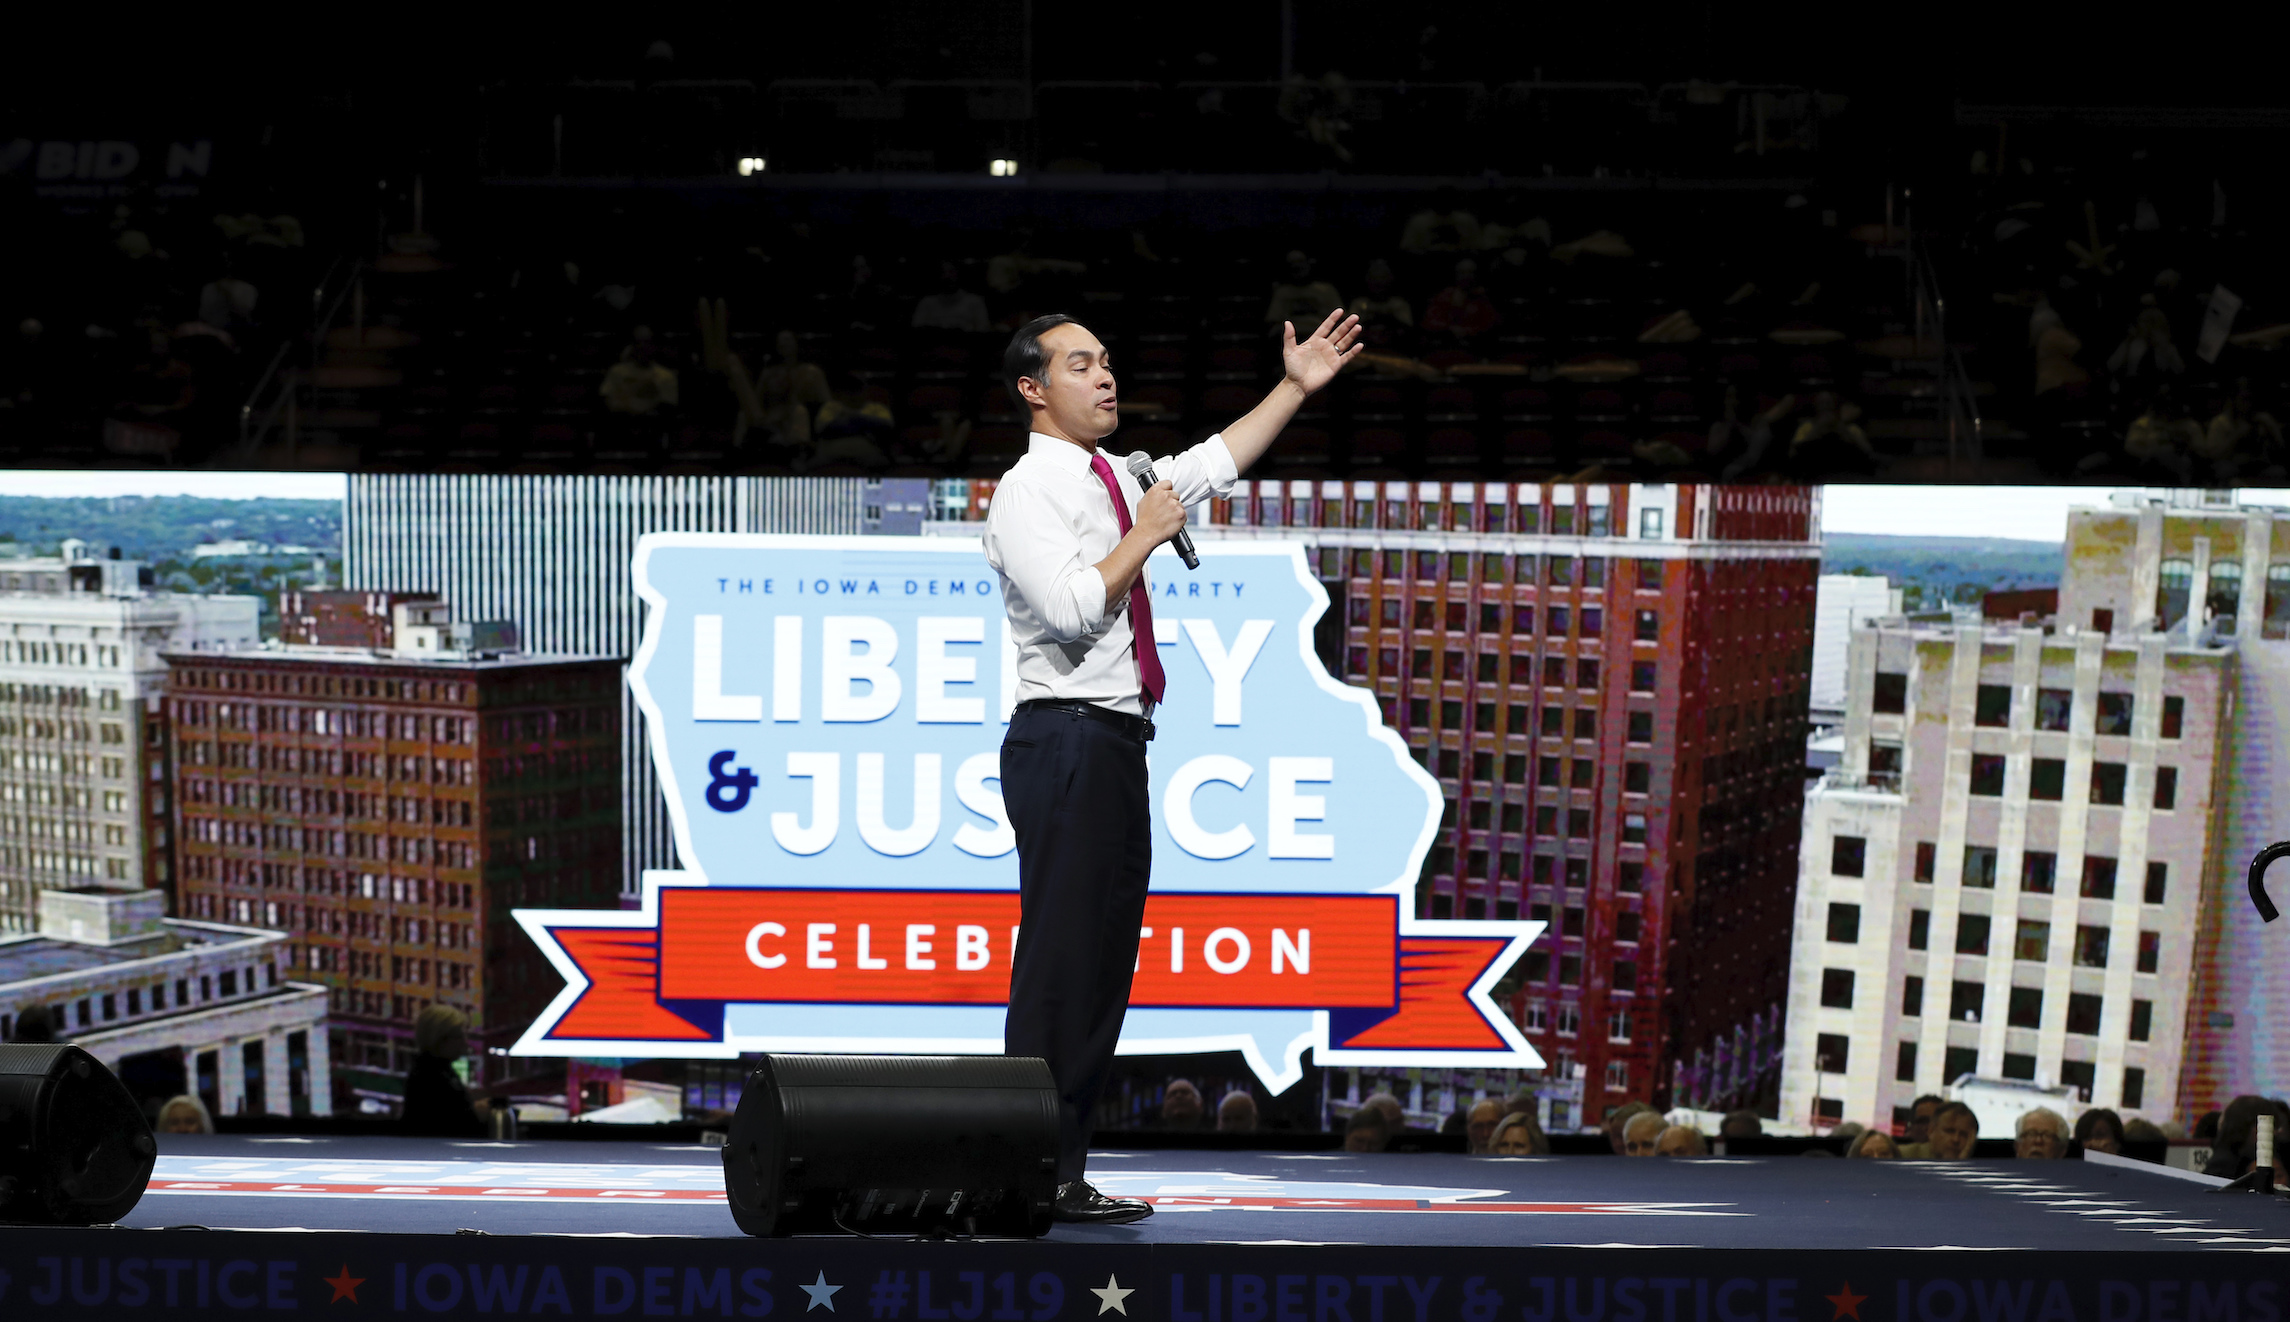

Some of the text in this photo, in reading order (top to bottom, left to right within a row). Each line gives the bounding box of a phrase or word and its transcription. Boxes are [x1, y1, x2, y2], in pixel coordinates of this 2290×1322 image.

[36, 138, 213, 179] BIDN
[716, 578, 774, 594] THE
[798, 579, 880, 595] IOWA
[692, 614, 1276, 728] LIBEY
[705, 749, 1335, 861] & JUSCE
[745, 921, 1310, 974] CELEBION
[29, 1257, 298, 1309] JUSTICE
[393, 1262, 774, 1317] IOWA DEMS
[867, 1270, 1064, 1320] #LJ19
[1170, 1273, 1798, 1322] LIBERTY & JUSTICE
[1896, 1279, 2281, 1322] IOWA DEMS
